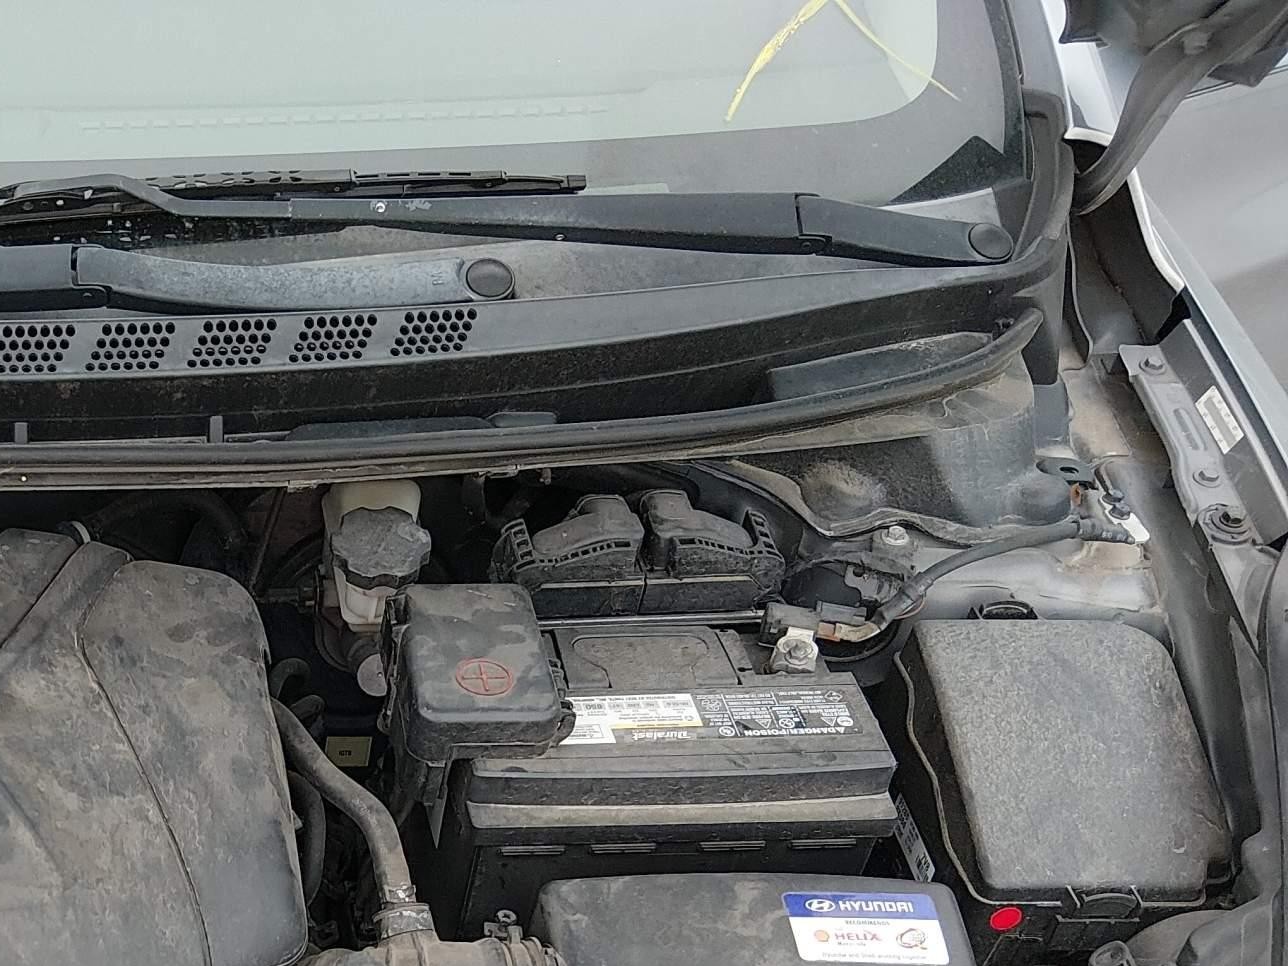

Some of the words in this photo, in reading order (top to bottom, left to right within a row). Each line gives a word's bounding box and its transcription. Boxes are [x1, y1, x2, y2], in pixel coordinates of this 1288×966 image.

[631, 731, 692, 741] Duralast
[743, 726, 836, 737] DANGER/POISON
[839, 900, 914, 913] HYUNDAI
[834, 932, 882, 942] HELIX
